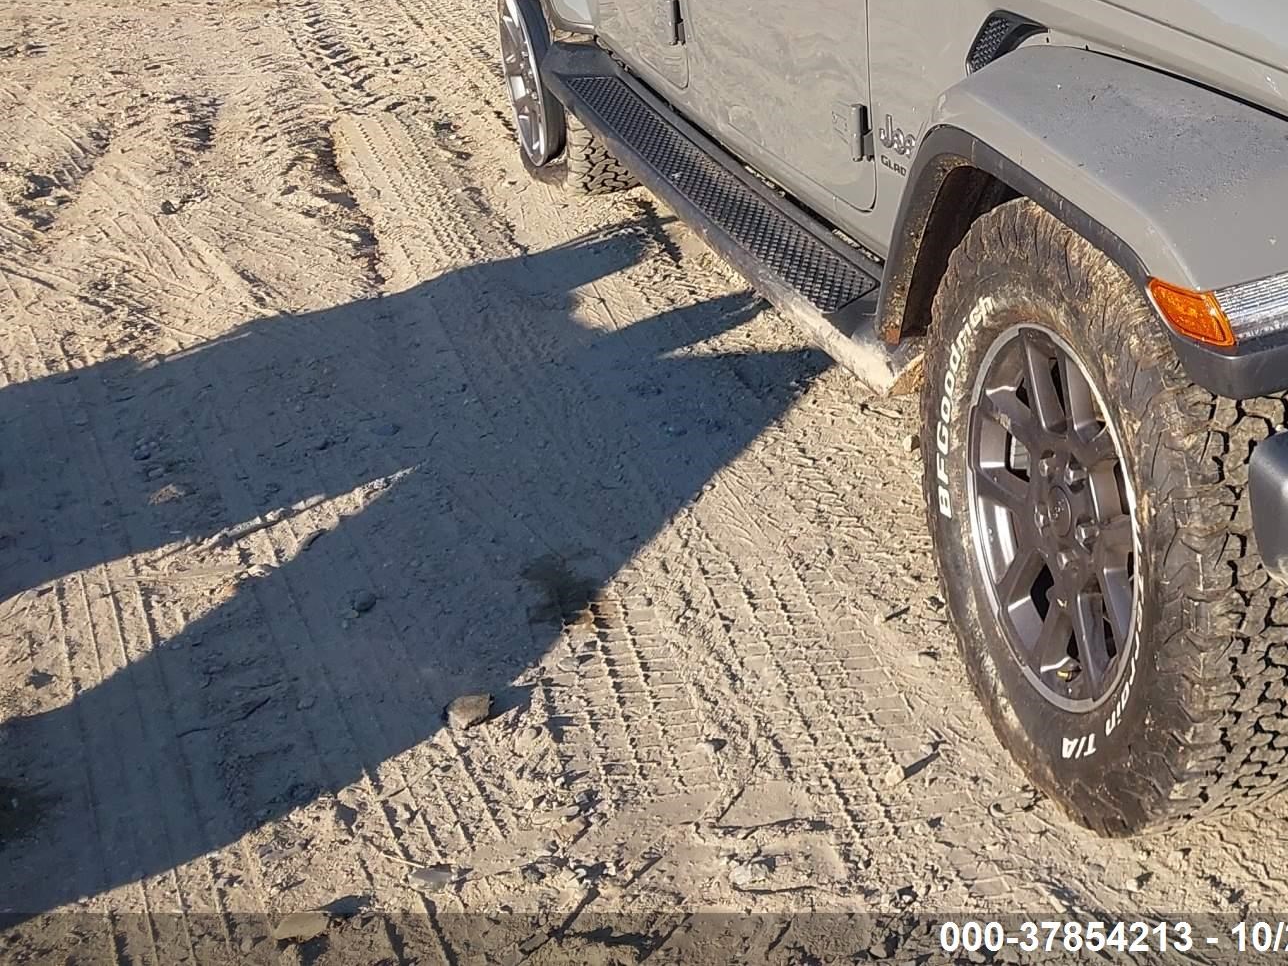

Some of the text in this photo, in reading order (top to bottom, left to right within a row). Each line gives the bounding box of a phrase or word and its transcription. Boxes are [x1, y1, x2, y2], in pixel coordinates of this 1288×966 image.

[879, 114, 917, 158] Jee
[880, 154, 907, 177] GLAD
[936, 295, 997, 519] BFGoodrich
[1061, 733, 1097, 759] T/A
